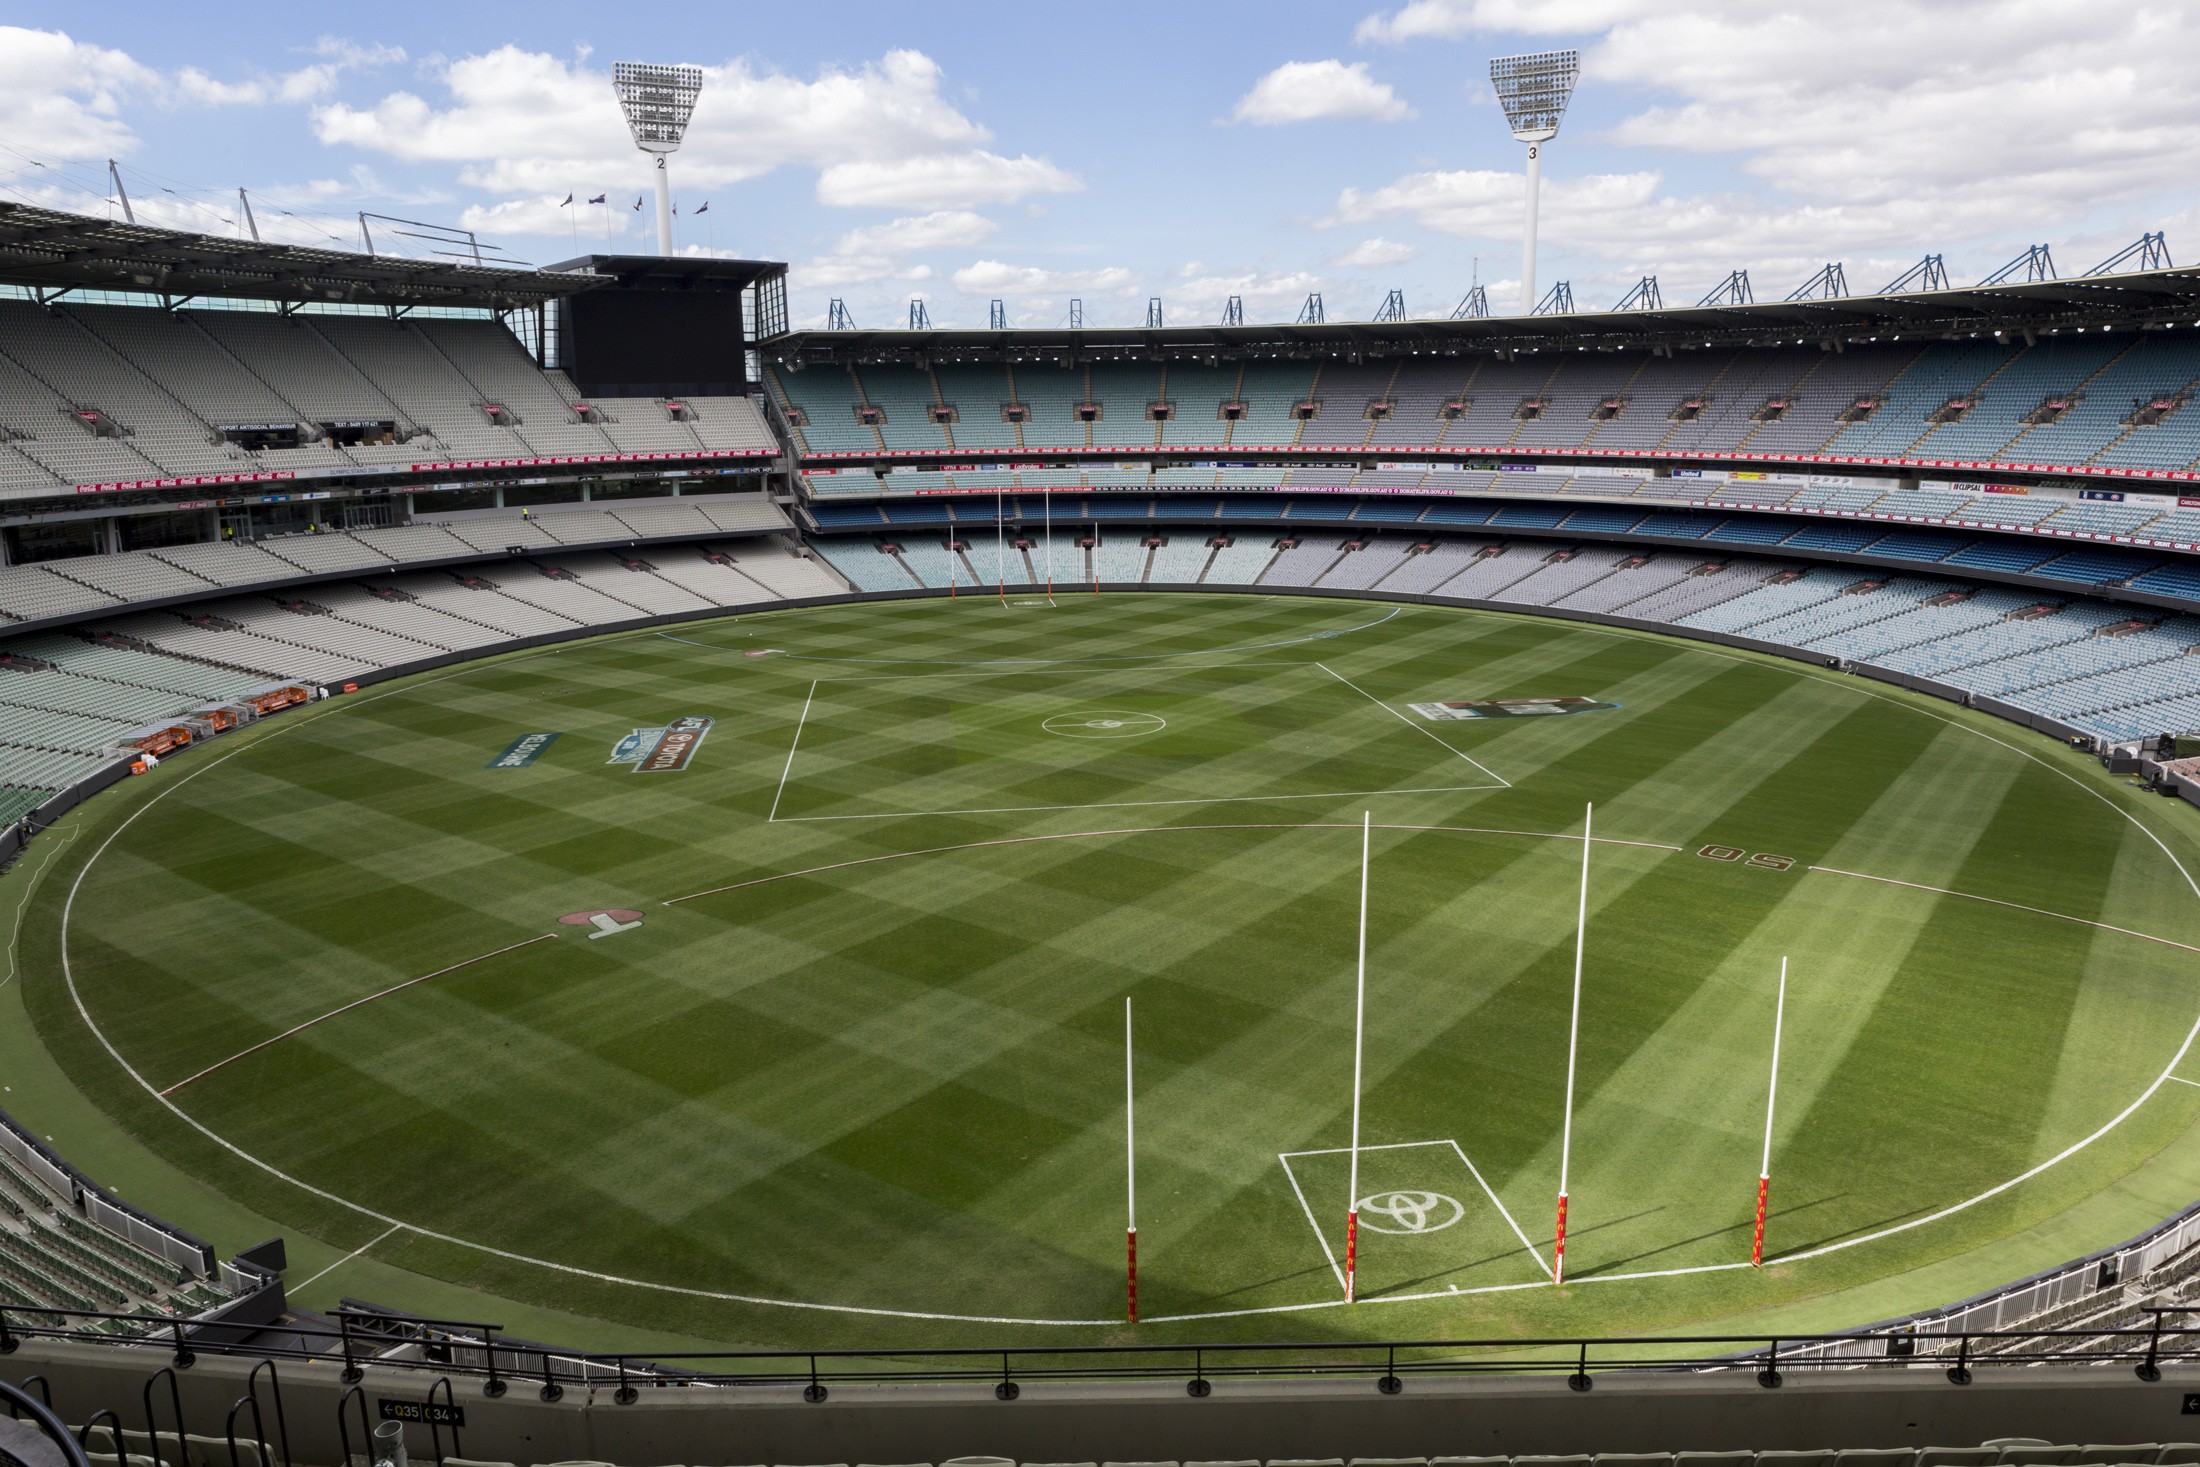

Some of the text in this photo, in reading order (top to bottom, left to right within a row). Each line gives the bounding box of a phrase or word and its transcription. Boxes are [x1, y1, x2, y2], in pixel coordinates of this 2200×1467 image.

[1528, 147, 1537, 159] 3
[657, 158, 665, 169] 2
[1958, 483, 1981, 491] CLIPSAL
[678, 717, 704, 731] AFL
[651, 743, 686, 769] TOYOTA
[394, 1405, 419, 1418] Q35
